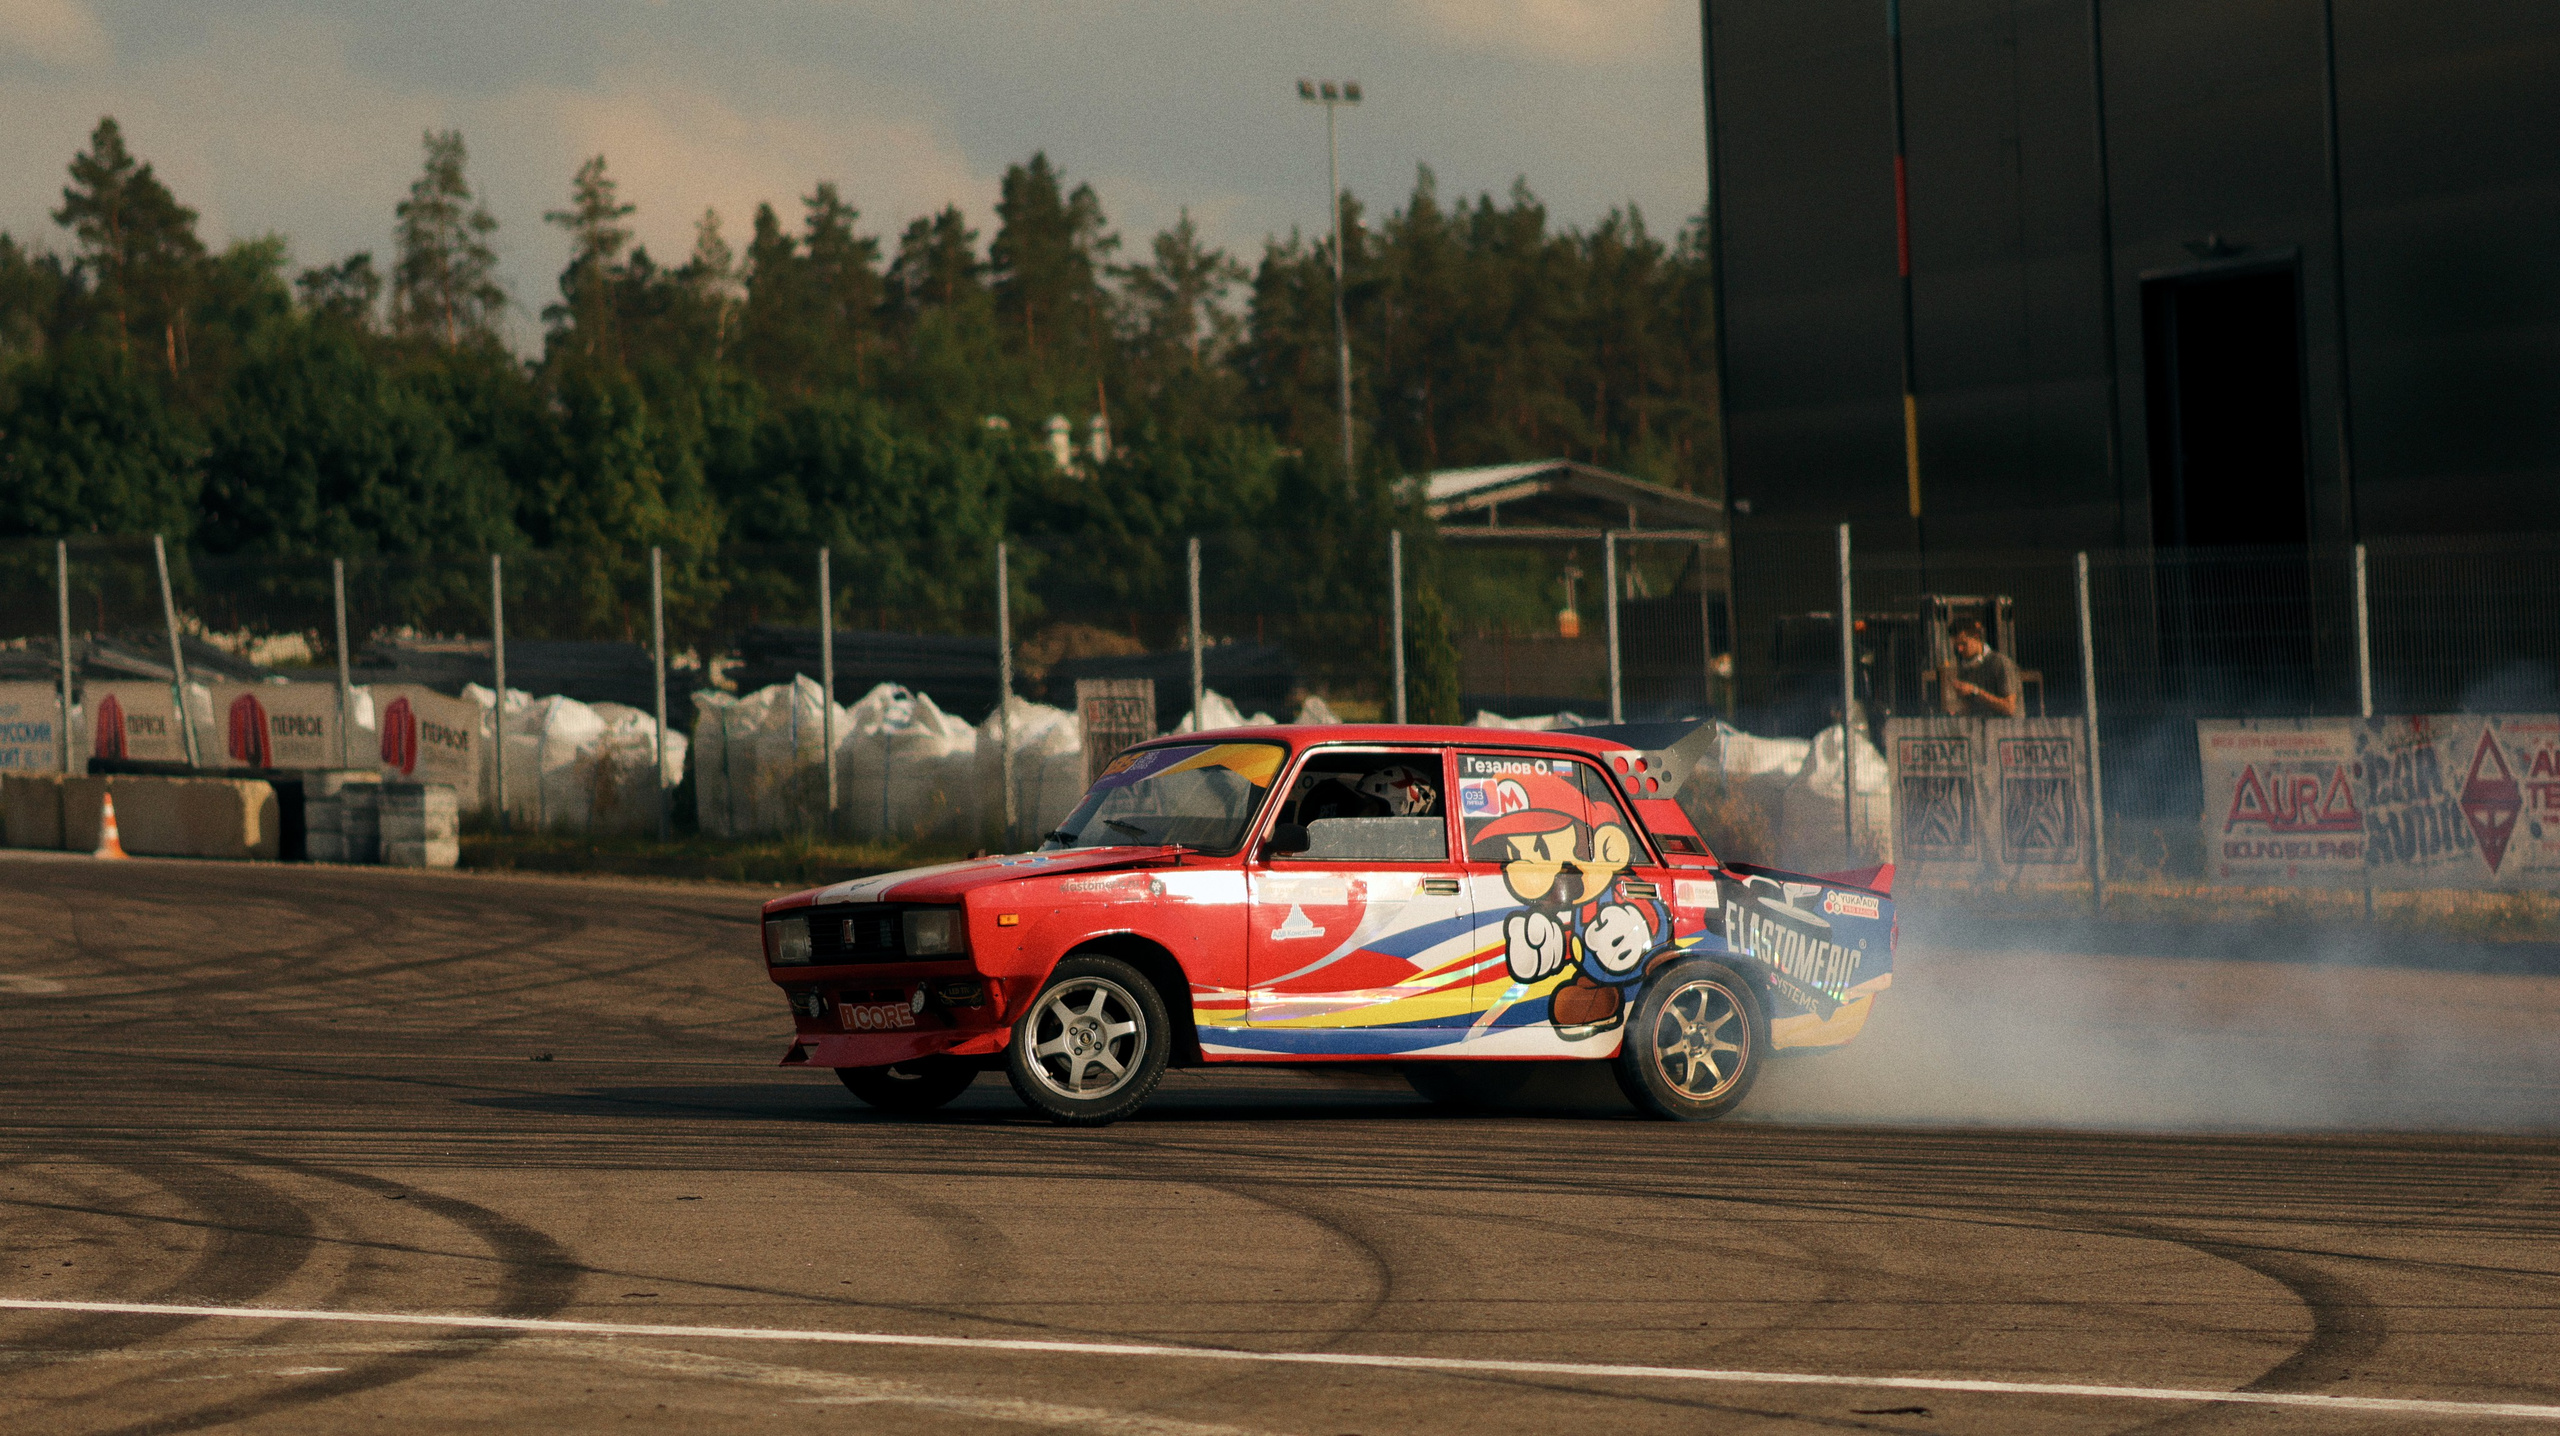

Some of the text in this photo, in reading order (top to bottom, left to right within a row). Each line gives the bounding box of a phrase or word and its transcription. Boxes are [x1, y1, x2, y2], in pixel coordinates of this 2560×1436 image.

[271, 716, 324, 736] ПЕРВОЕ
[422, 720, 469, 752] ПЕРВОЕ
[1466, 757, 1552, 776] Гезалов О.
[2223, 764, 2362, 833] AURA
[1840, 895, 1878, 908] YUKA ADV
[1726, 900, 1861, 1002] ELASTOMERIC
[1770, 972, 1819, 1013] SYSTEMS
